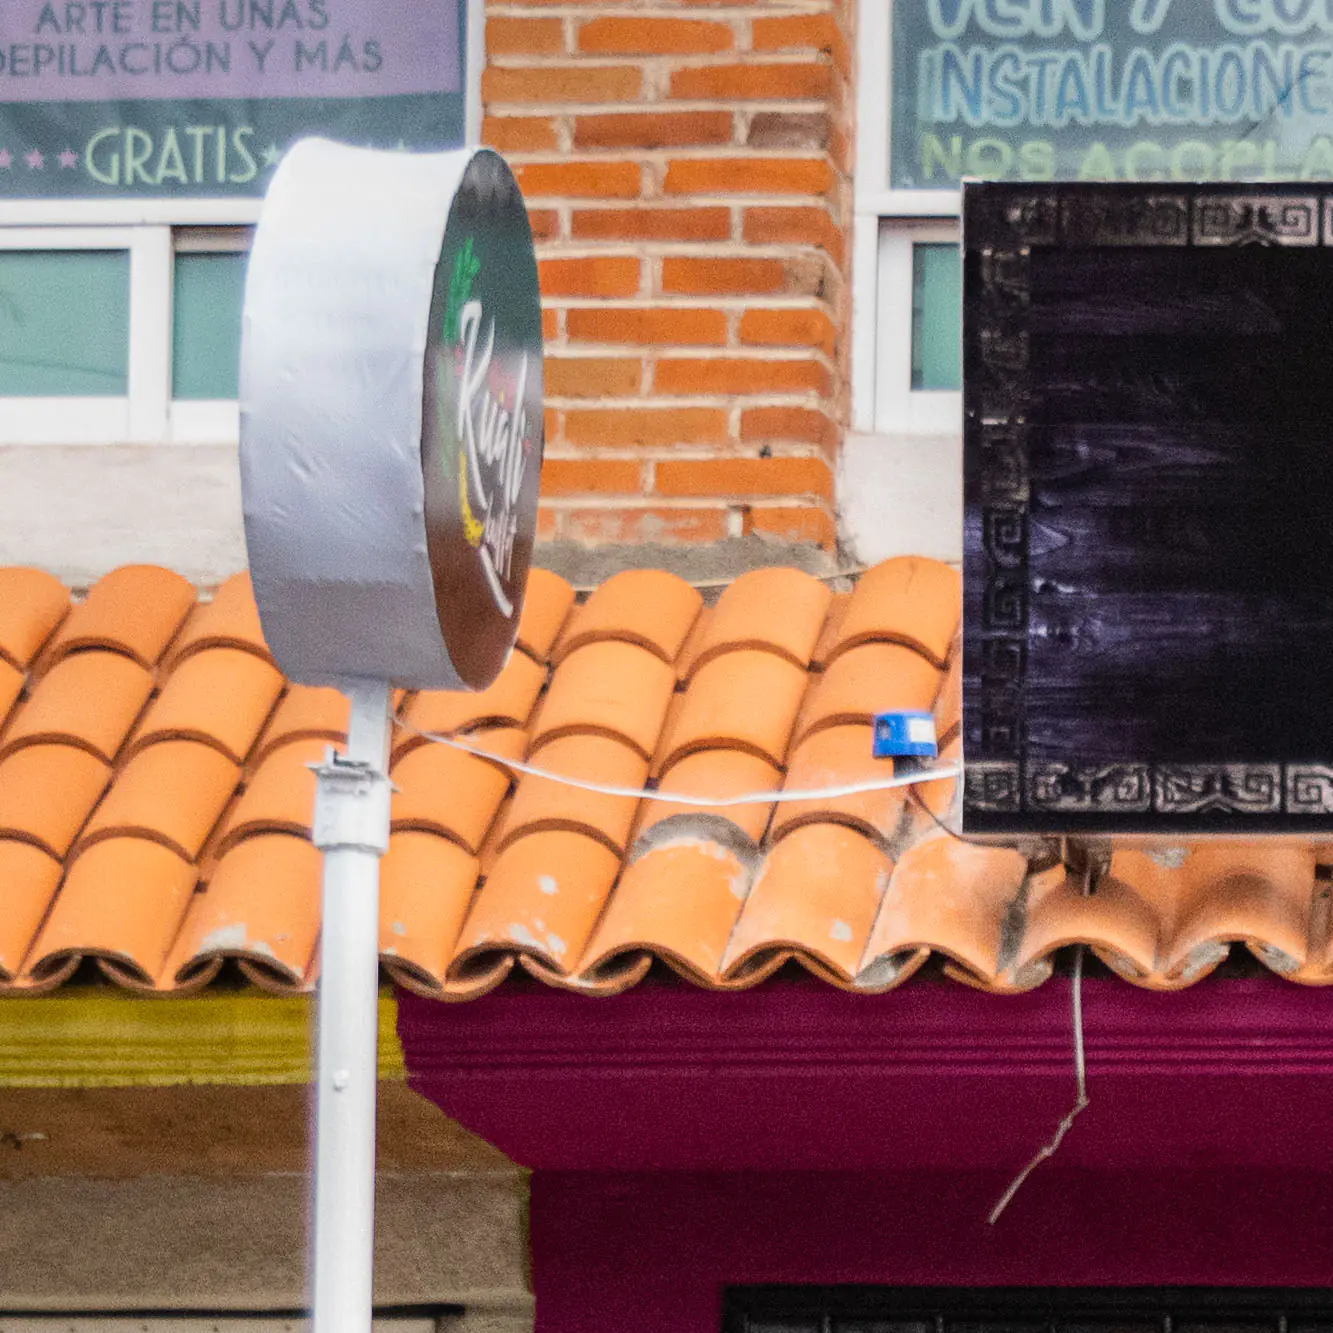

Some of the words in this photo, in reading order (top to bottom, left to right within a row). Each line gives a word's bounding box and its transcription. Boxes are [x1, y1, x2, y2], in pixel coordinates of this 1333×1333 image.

[34, 0, 132, 34] ARTE
[151, 0, 200, 33] EN
[0, 34, 230, 77] EPILACIÓN
[248, 40, 275, 72] Y
[295, 33, 383, 73] MÁS
[85, 125, 258, 185] GRATIS
[921, 133, 1056, 180] NOS
